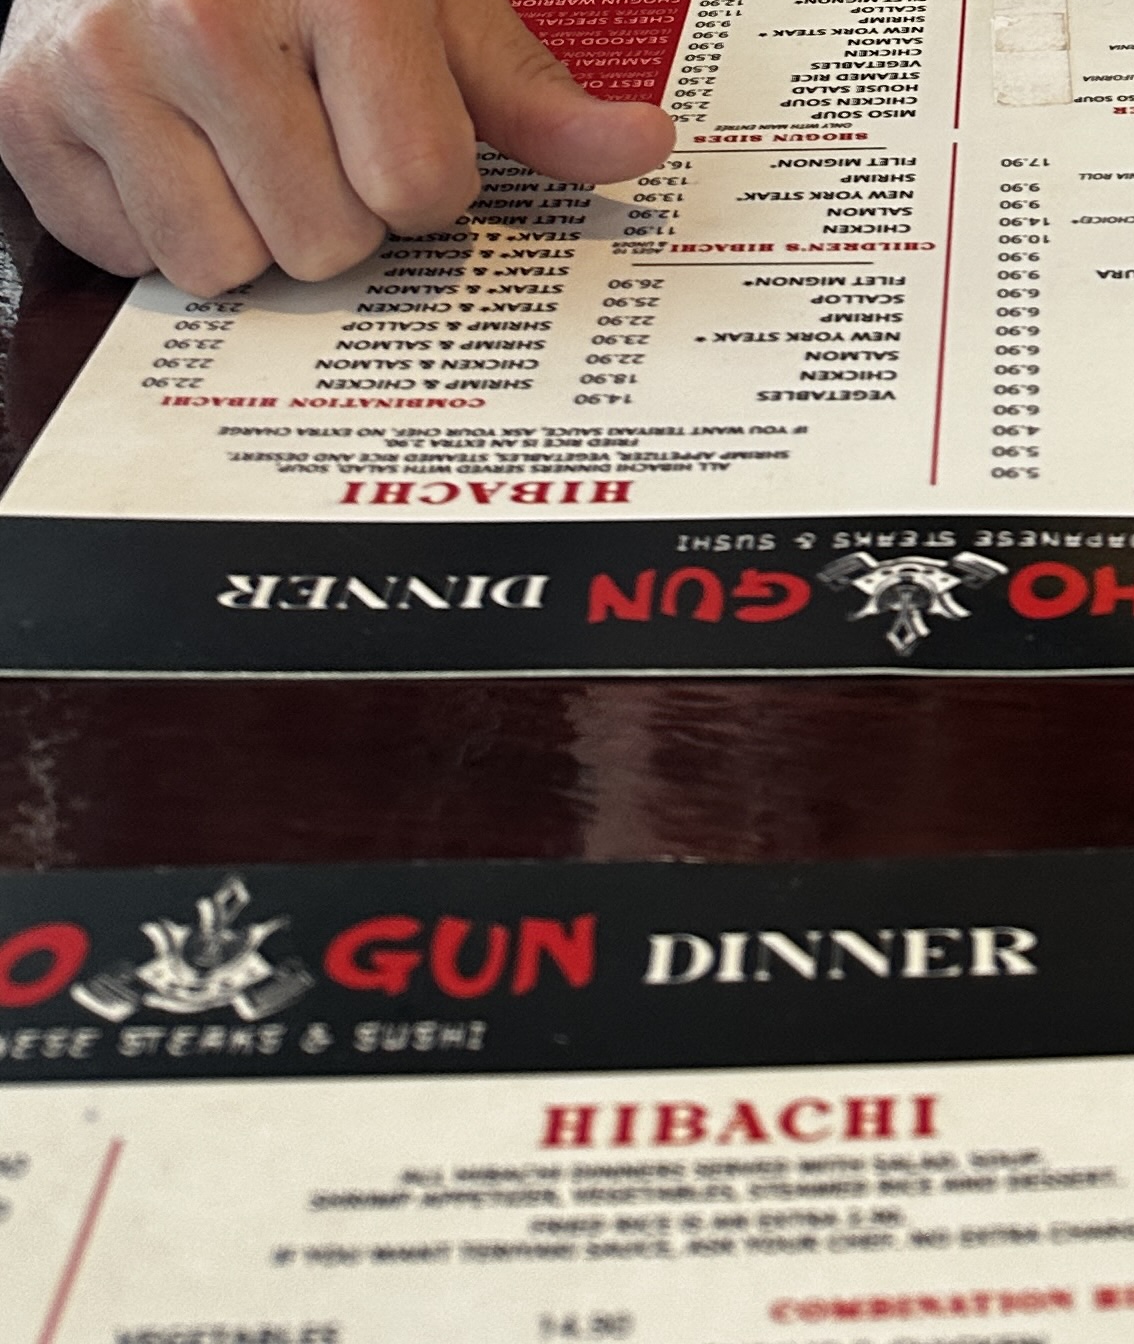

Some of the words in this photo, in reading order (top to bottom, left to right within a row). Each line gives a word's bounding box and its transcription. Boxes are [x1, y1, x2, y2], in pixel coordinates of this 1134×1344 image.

[674, 89, 714, 97] 2.90
[791, 86, 852, 94] SALAD
[855, 84, 919, 93] HOUSE
[670, 101, 711, 110] 2.50
[779, 99, 832, 107] SOUP
[836, 97, 918, 106] CHICKEN
[810, 111, 863, 119] SOUP
[866, 110, 917, 118] MISO
[692, 135, 763, 143] SIDES
[772, 133, 869, 142] SHOGUN
[1000, 158, 1051, 167] 17.90
[999, 183, 1041, 192] 9.90
[999, 200, 1041, 209] 9.90
[998, 218, 1051, 226] 14.90
[998, 235, 1051, 244] 10.90
[669, 243, 775, 252] HIBACHI
[784, 242, 937, 252] CHILDREN'S
[997, 252, 1041, 262] 9.90
[997, 270, 1041, 280] 9.90
[607, 279, 665, 289] 26.90
[850, 276, 907, 286] FILET
[996, 289, 1041, 298] 6.90
[602, 297, 661, 307] 25.90
[809, 294, 905, 304] SCALLOP
[995, 307, 1040, 317] 6.90
[596, 316, 656, 326] 22.90
[818, 313, 904, 323] SHRIMP
[174, 321, 235, 331] 25.90
[340, 321, 441, 331] SCALLOP
[445, 321, 463, 331] &
[466, 321, 553, 331] SHRIMP
[995, 326, 1041, 336] 6.90
[590, 335, 651, 345] 23.90
[712, 332, 781, 342] STEAK
[785, 332, 846, 342] YORK
[849, 331, 901, 342] NEW
[163, 339, 225, 349] 23.90
[335, 340, 433, 350] SALMON
[438, 340, 456, 350] &
[458, 340, 547, 350] SHRIMP
[994, 345, 1040, 355] 6.90
[584, 354, 646, 364] 22.90
[804, 351, 900, 361] SALMON
[152, 358, 215, 368] 22.90
[314, 359, 413, 370] SALMON
[418, 360, 436, 370] &
[440, 359, 540, 370] CHICKEN
[994, 365, 1041, 375] 6.90
[579, 374, 638, 384] 18.90
[799, 370, 898, 381] CHICKEN
[141, 377, 205, 388] 22.90
[315, 379, 417, 390] CHICKEN
[422, 379, 441, 389] &
[444, 379, 534, 390] SHRIMP
[993, 385, 1040, 395] 6.90
[573, 394, 632, 405] 14.90
[756, 390, 897, 401] VEGETABLES
[160, 396, 279, 407] HIBACHI
[288, 398, 486, 408] COMBINATION
[992, 405, 1040, 415] 6.90
[991, 425, 1041, 436] 4.90
[991, 446, 1040, 457] 5.90
[990, 467, 1040, 478] 5.90
[338, 480, 635, 505] HIBACHI
[677, 533, 776, 552] SUSHI
[793, 531, 817, 550] &
[833, 531, 957, 549] STEAKS
[216, 573, 550, 610] DINNER
[586, 567, 812, 625] GUN
[323, 914, 598, 999] GUN
[643, 926, 1038, 986] DINNER
[118, 1021, 288, 1058] STEAKS
[300, 1021, 334, 1055] &
[352, 1019, 488, 1053] SUSHI
[540, 1094, 939, 1150] HIBACHI
[768, 1286, 1073, 1324] COMBINATION
